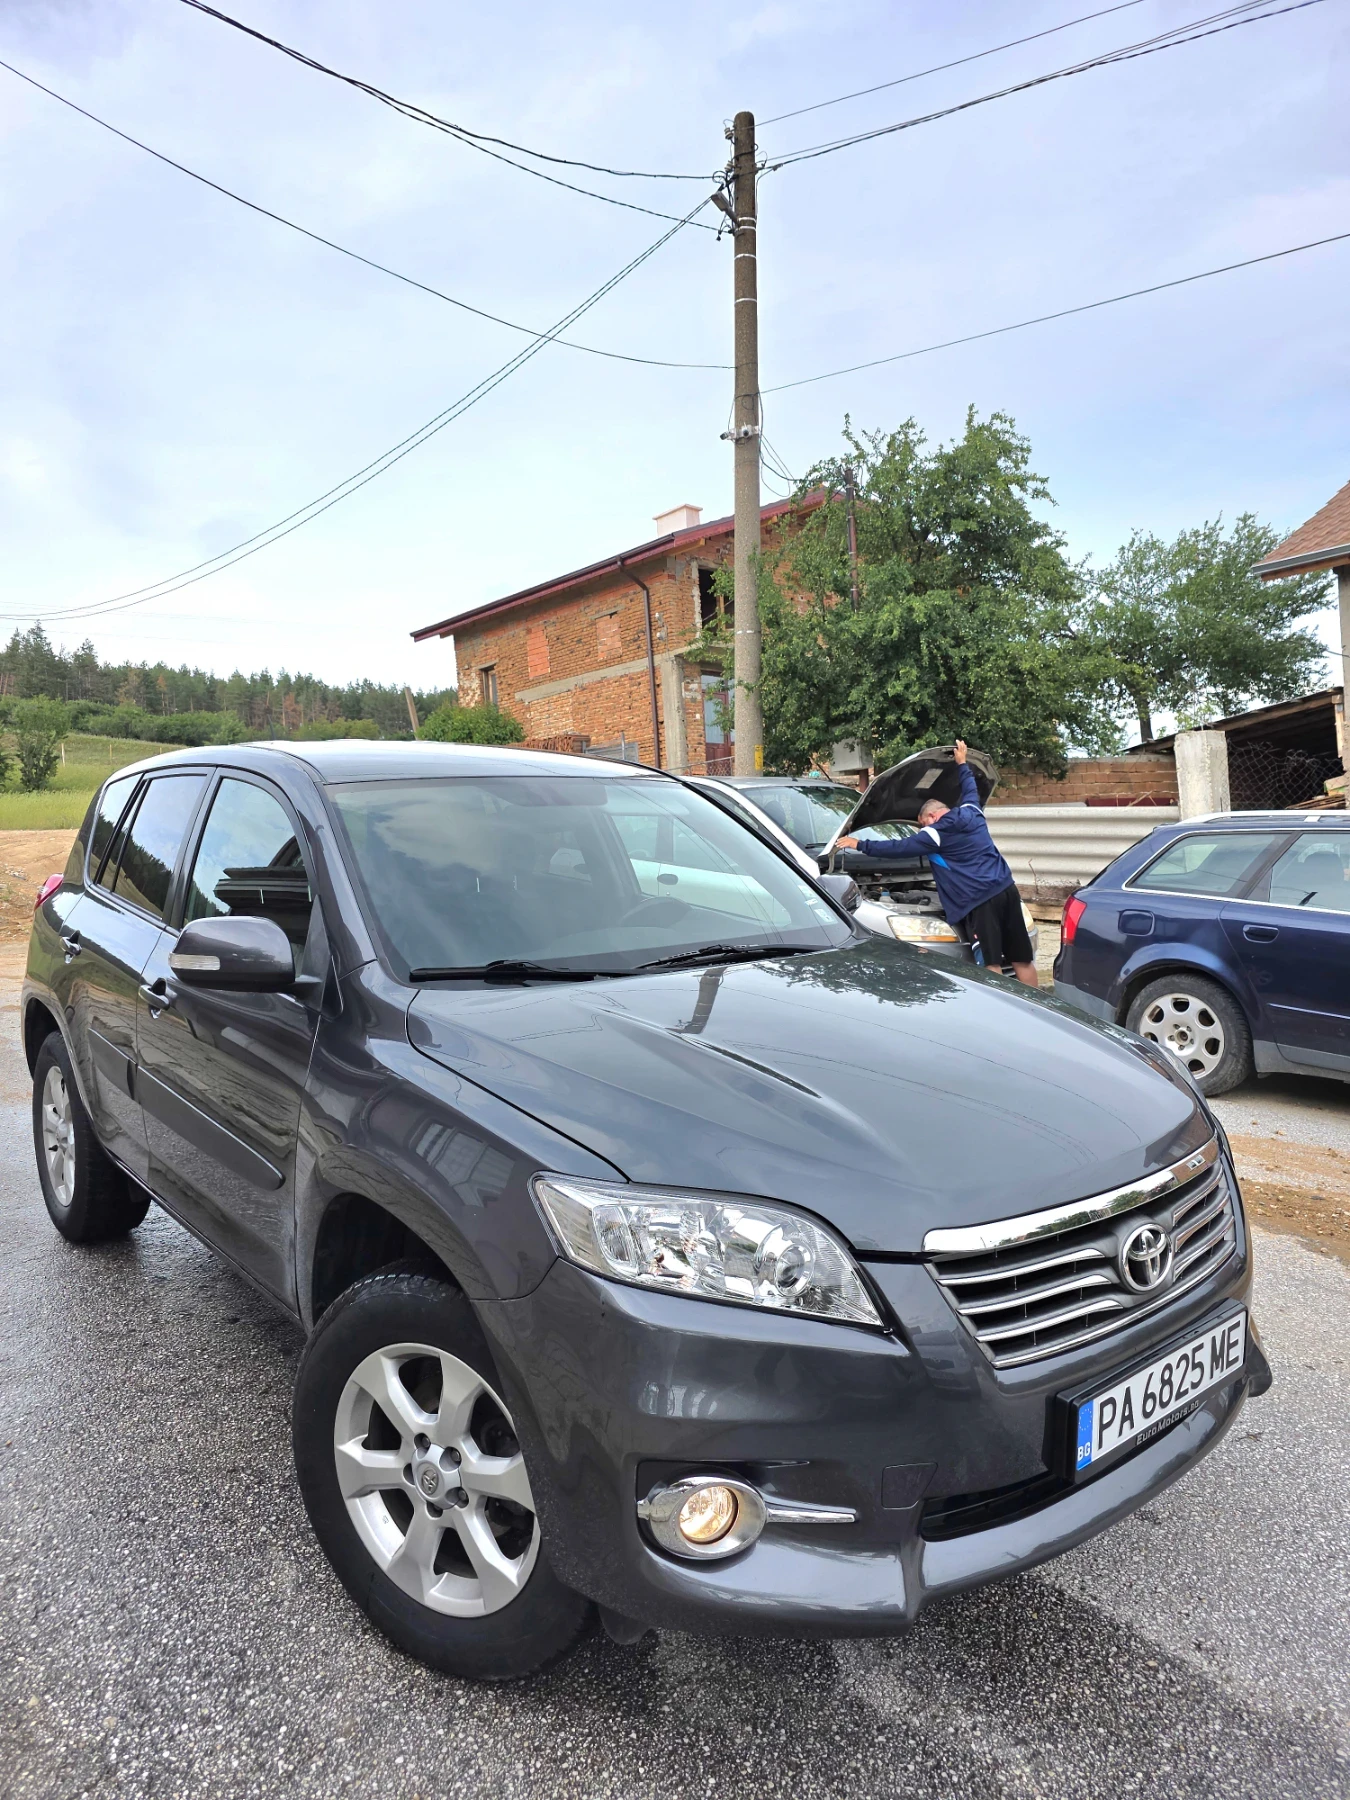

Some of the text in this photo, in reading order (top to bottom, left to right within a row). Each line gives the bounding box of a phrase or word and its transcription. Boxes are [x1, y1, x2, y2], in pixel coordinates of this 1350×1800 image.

[1097, 1320, 1241, 1450] PA 6825 ME
[1077, 1442, 1091, 1461] BG
